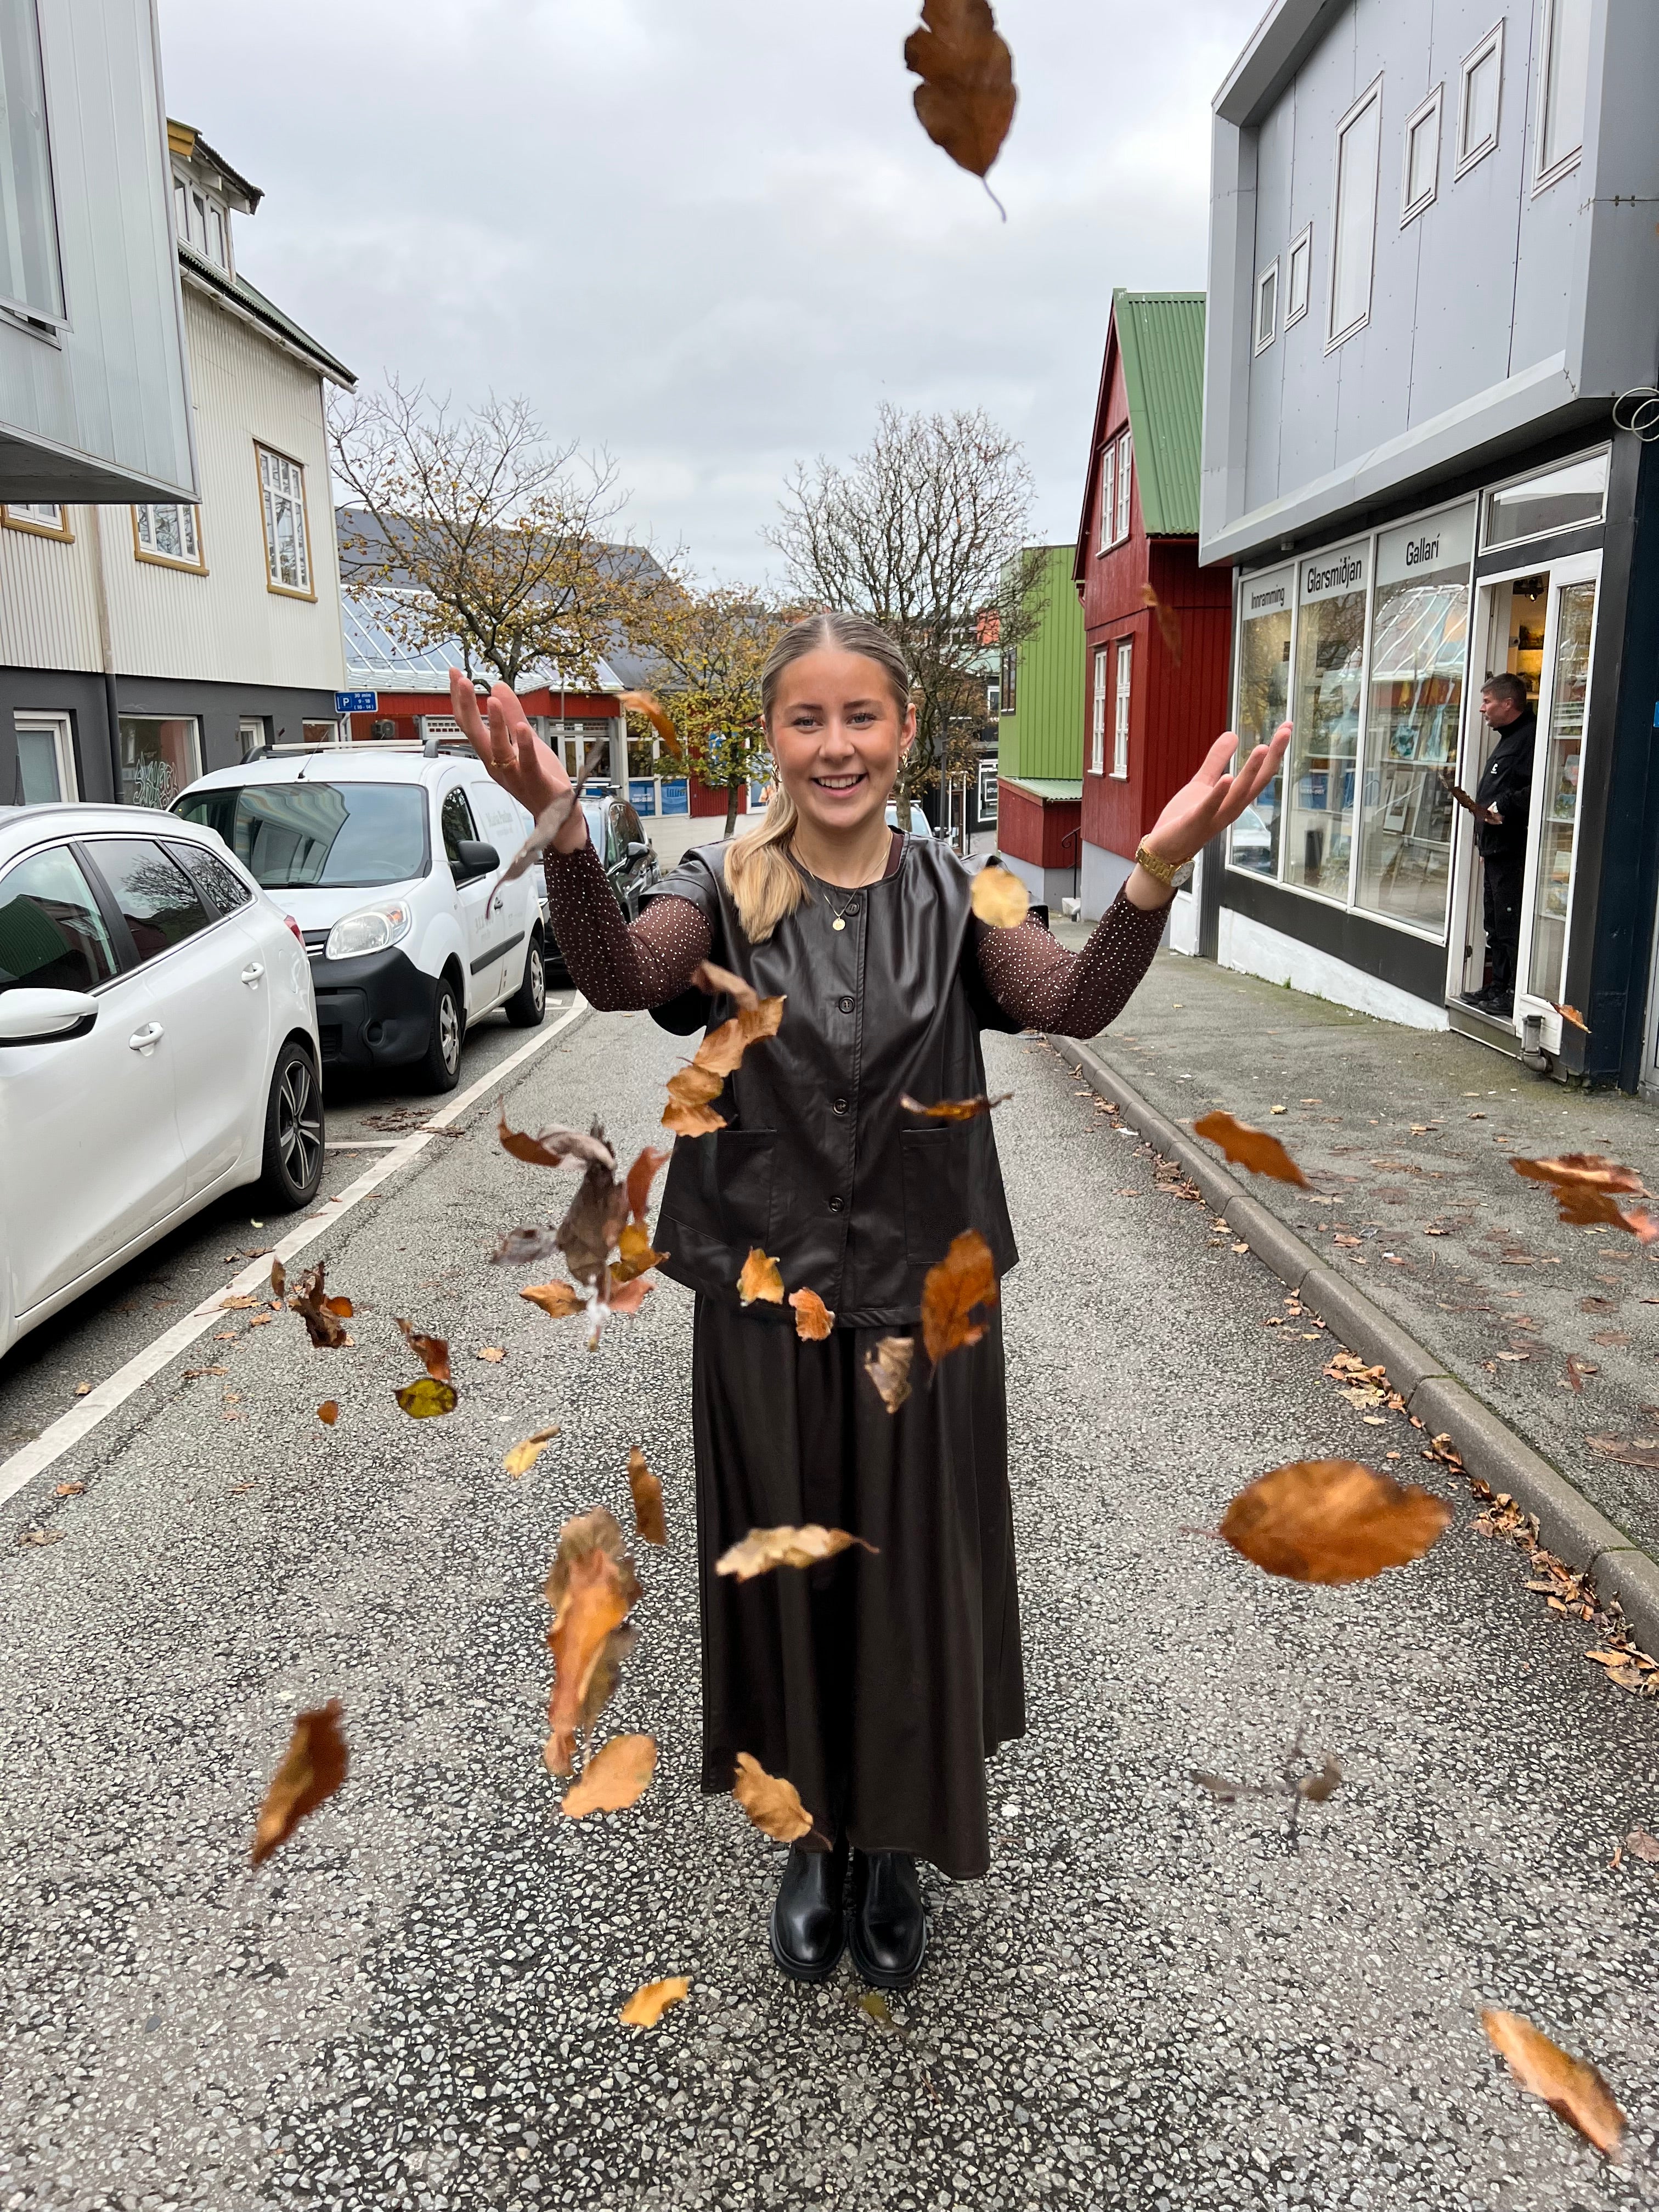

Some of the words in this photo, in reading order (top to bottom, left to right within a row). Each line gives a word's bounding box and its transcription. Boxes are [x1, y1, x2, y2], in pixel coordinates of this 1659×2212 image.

[1406, 533, 1440, 566] Gallarí
[1307, 555, 1362, 594] Glarsmiðjan
[1251, 584, 1285, 610] Innramming
